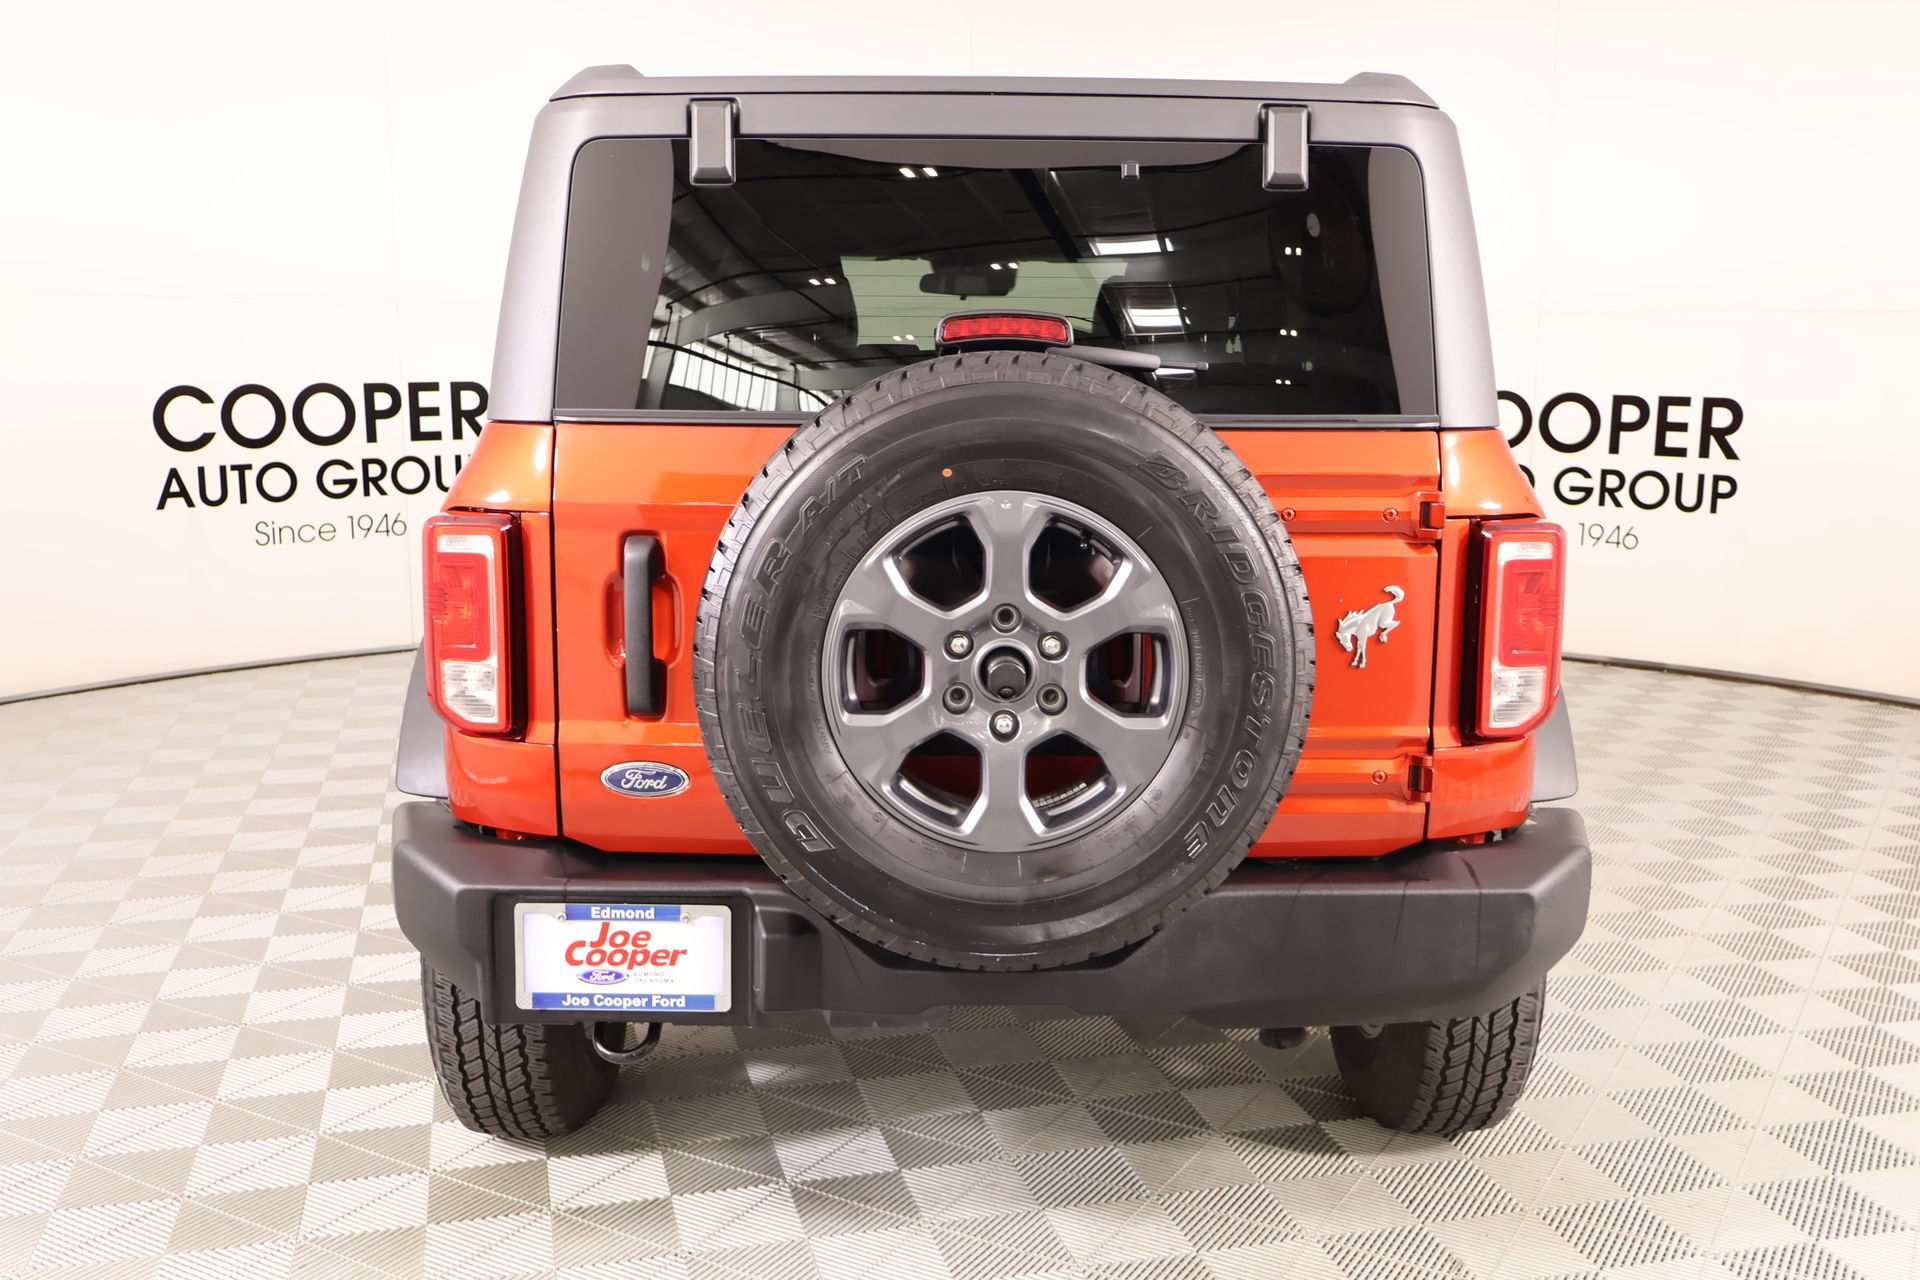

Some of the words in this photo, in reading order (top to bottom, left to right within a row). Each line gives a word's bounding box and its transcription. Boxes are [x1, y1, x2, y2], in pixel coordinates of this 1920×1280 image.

[153, 381, 489, 452] COOPER
[156, 461, 298, 510] AUTO
[316, 454, 471, 500] GROU
[1553, 466, 1738, 514] GROUP
[255, 520, 337, 546] Since
[347, 512, 408, 540] 1946
[1578, 522, 1639, 550] 1946
[1136, 451, 1277, 860] BRIDGESTONE
[621, 768, 668, 790] Ford
[591, 906, 655, 919] Edmond
[590, 921, 652, 949] Joe
[565, 940, 688, 970] Cooper
[589, 969, 617, 982] Ford
[562, 994, 589, 1007] Joe
[593, 995, 648, 1009] Cooper
[652, 995, 686, 1008] Ford
